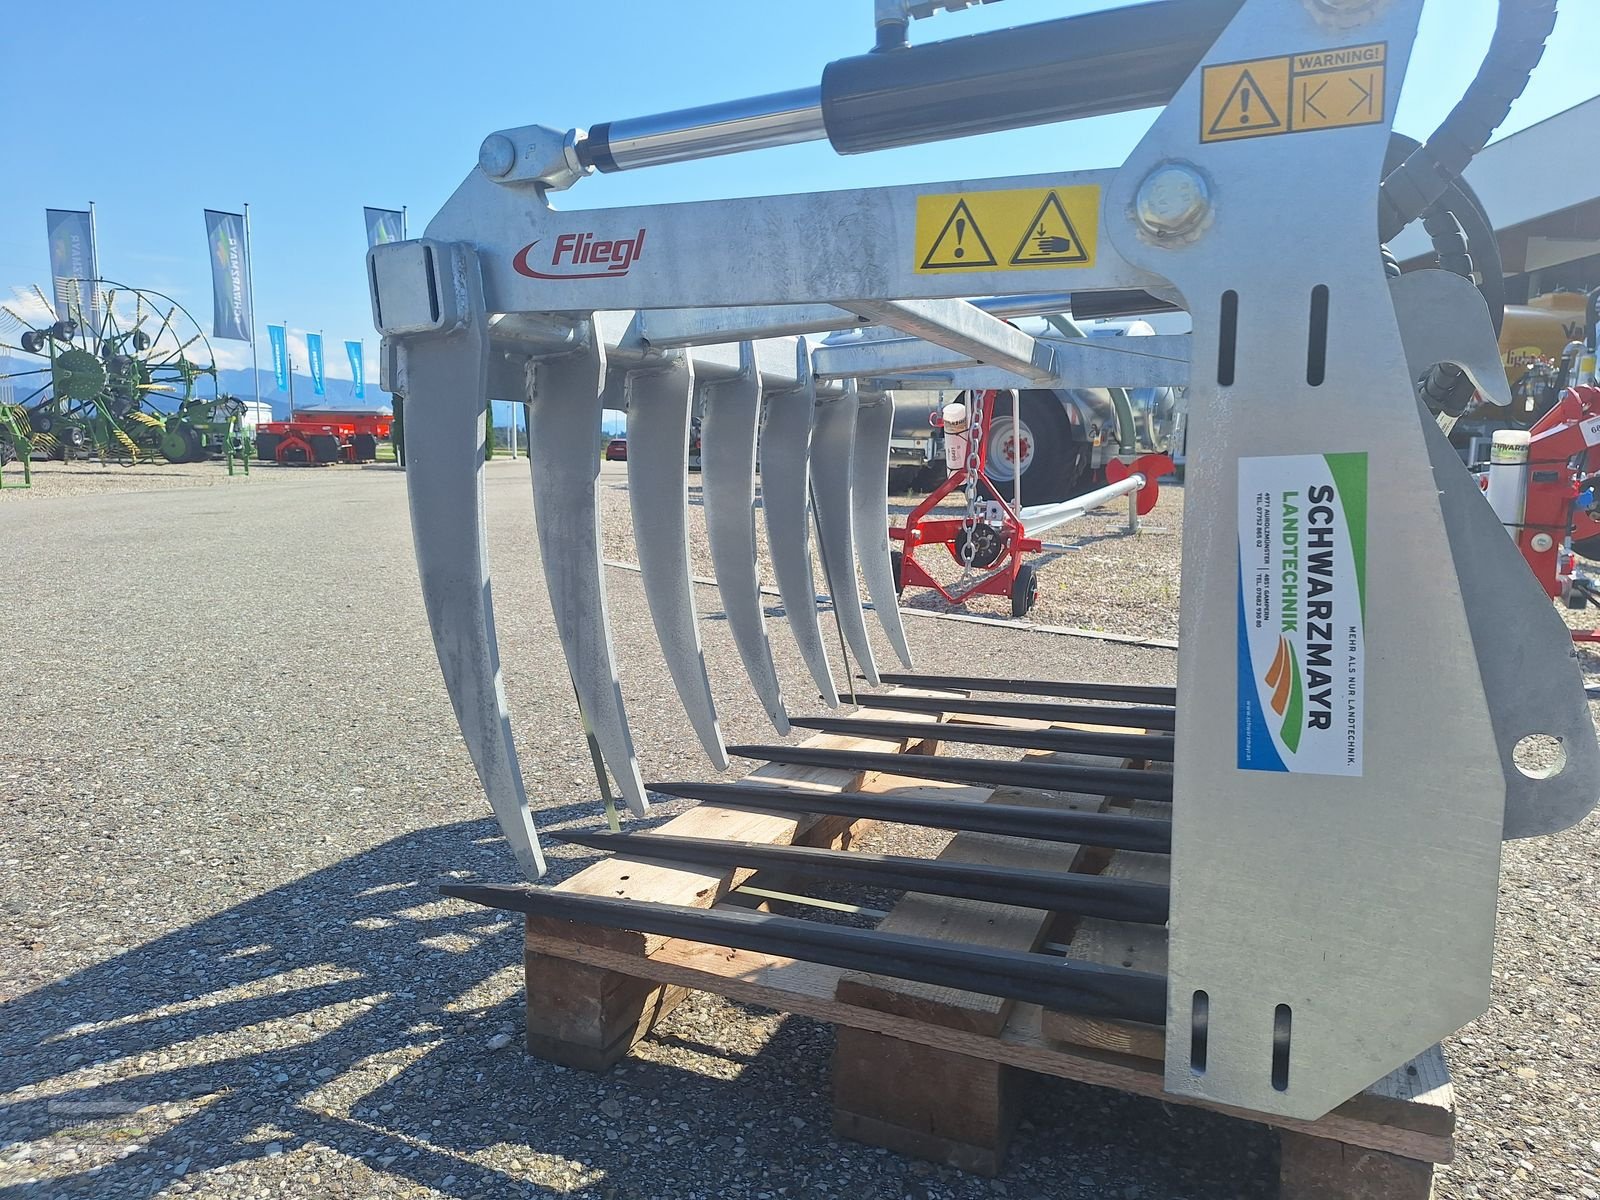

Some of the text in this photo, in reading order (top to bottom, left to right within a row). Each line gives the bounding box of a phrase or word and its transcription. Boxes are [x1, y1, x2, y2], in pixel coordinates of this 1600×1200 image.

[1299, 48, 1379, 69] WARNING!
[552, 229, 646, 270] Fliegl
[1256, 540, 1262, 548] 02
[1264, 509, 1272, 564] AUROLZMÜNSTER
[1280, 491, 1299, 633] LANDTECHNIK
[1307, 485, 1334, 730] SCHWARZMAYR
[1349, 626, 1357, 652] MEHR
[1348, 678, 1356, 697] NUR
[1347, 699, 1356, 767] LANDTECHNIK.
